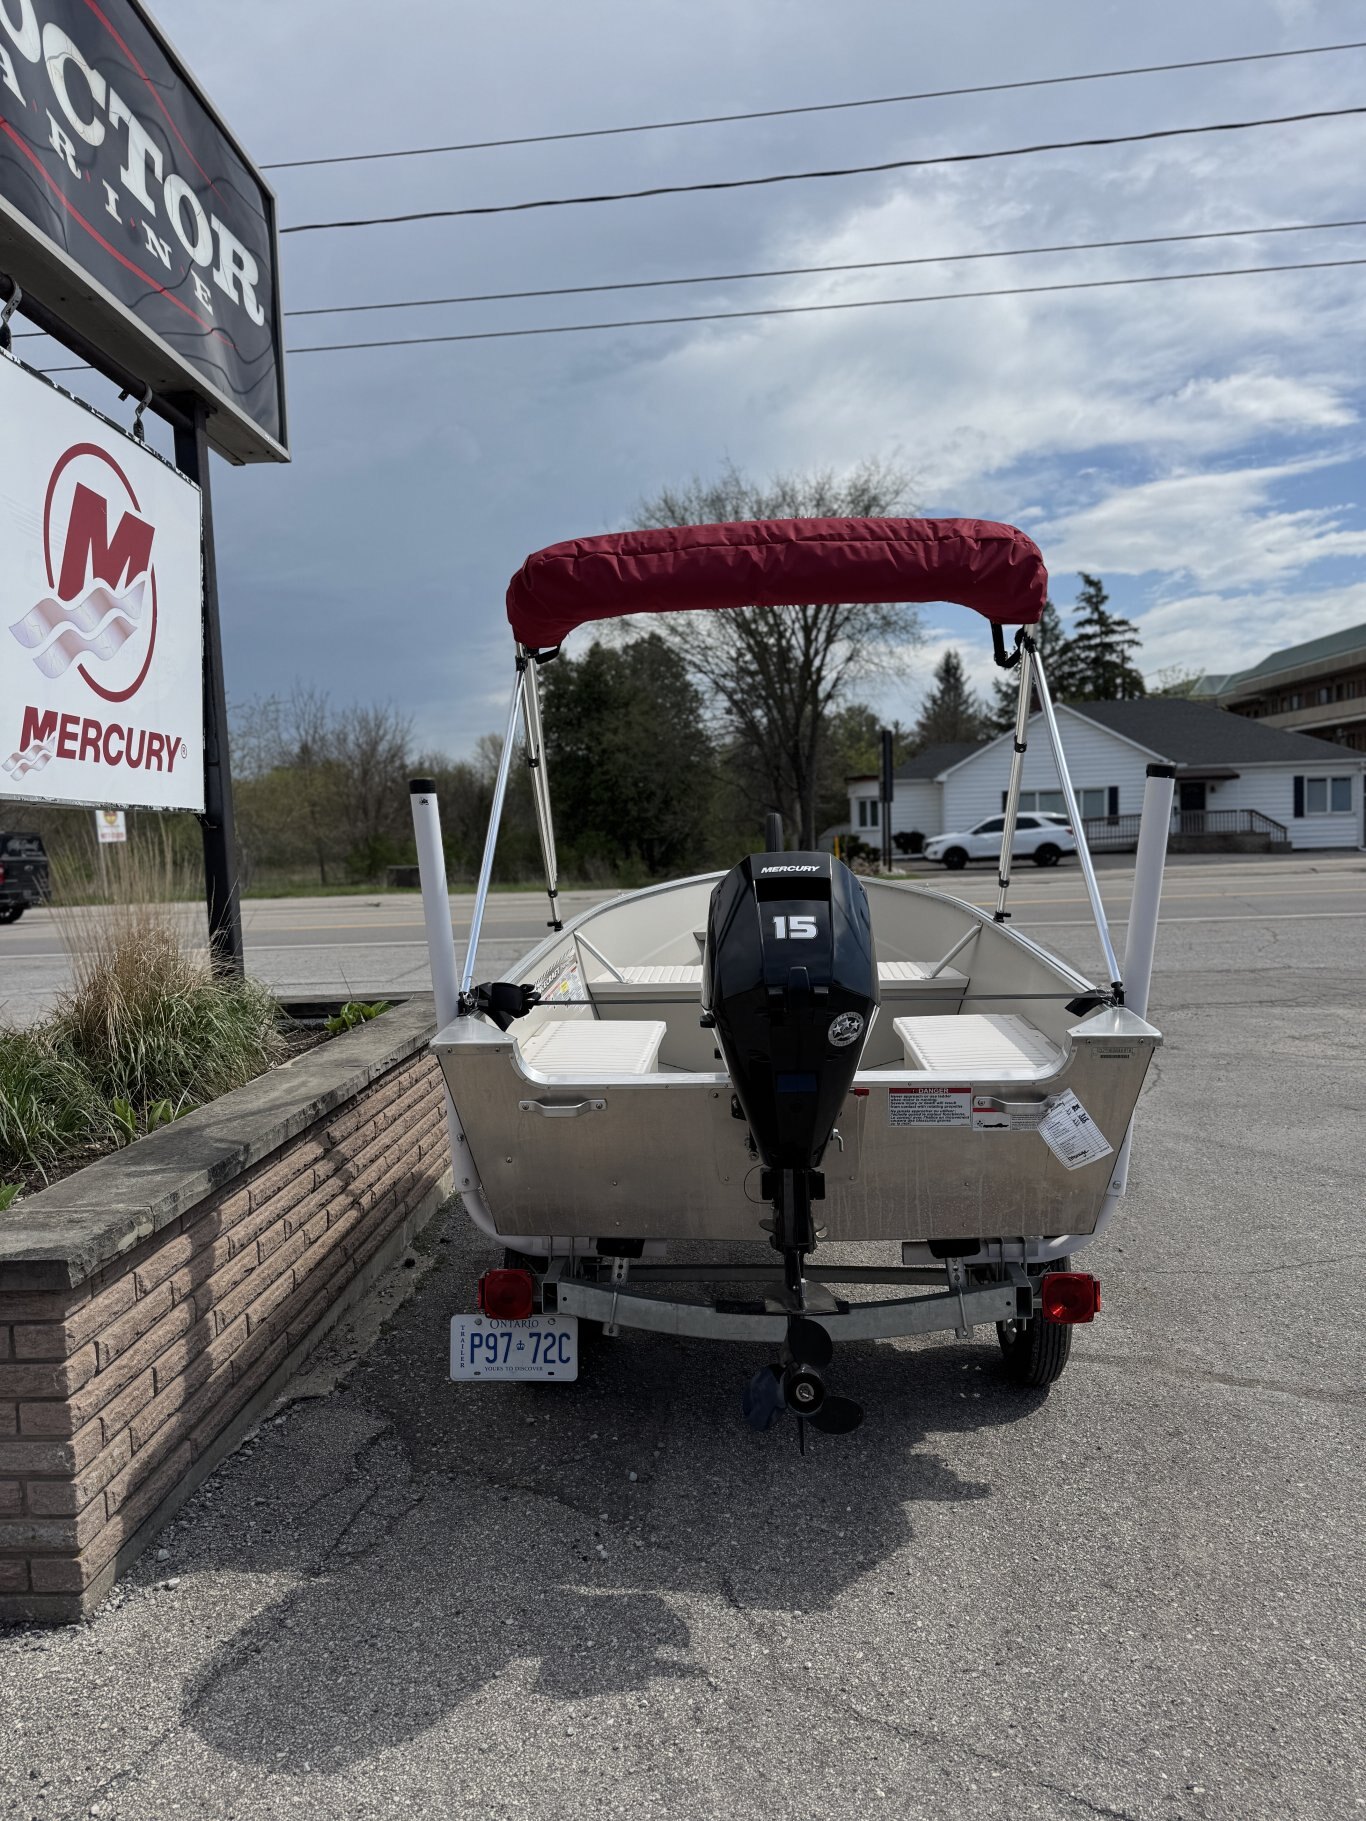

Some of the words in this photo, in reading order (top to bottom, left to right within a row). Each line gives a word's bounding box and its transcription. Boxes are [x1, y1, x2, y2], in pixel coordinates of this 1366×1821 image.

[20, 705, 182, 773] MERCURY
[761, 865, 820, 874] MERCURY
[773, 915, 819, 940] 15
[489, 1319, 540, 1330] ONTARIO
[470, 1332, 513, 1365] P97
[529, 1332, 571, 1364] 72C
